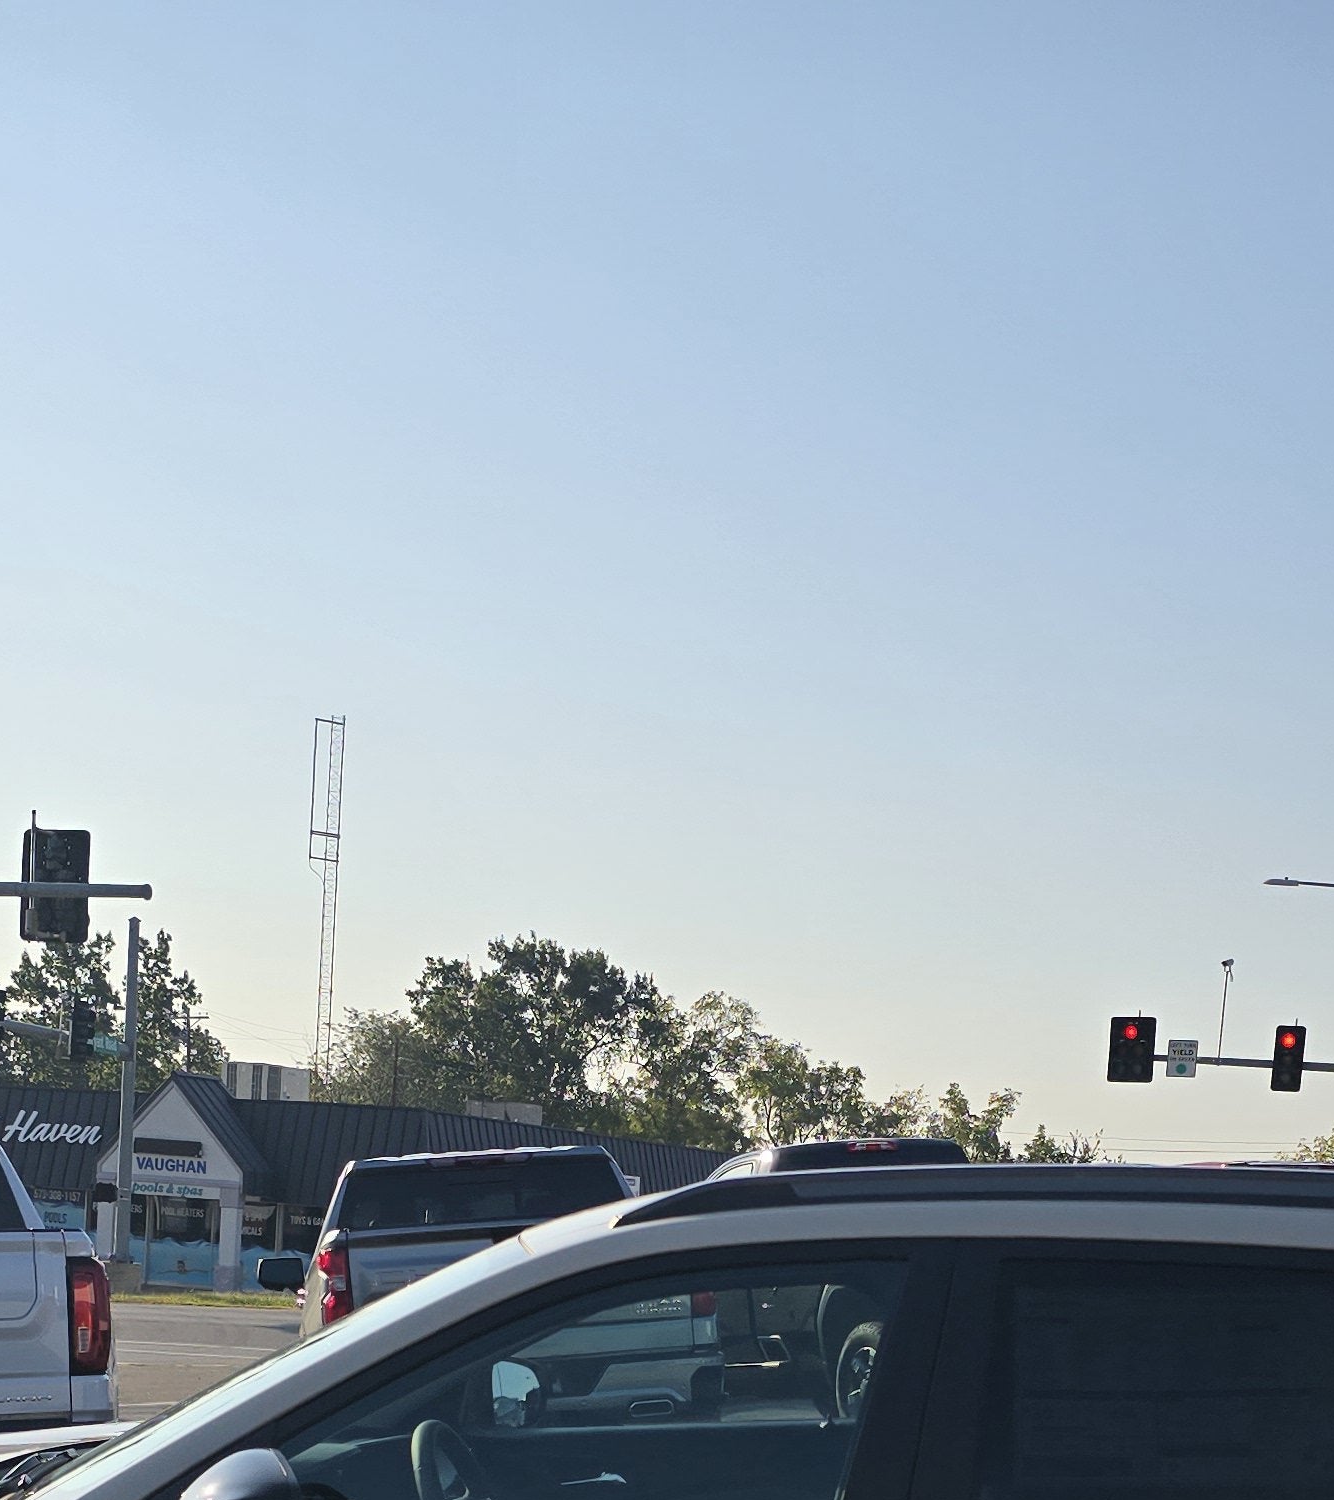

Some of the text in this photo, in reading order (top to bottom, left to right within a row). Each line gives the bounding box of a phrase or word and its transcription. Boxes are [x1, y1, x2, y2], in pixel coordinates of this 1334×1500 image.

[1, 1109, 103, 1146] Haven
[136, 1157, 208, 1175] VAUGHAN
[132, 1182, 204, 1198] pools & spas
